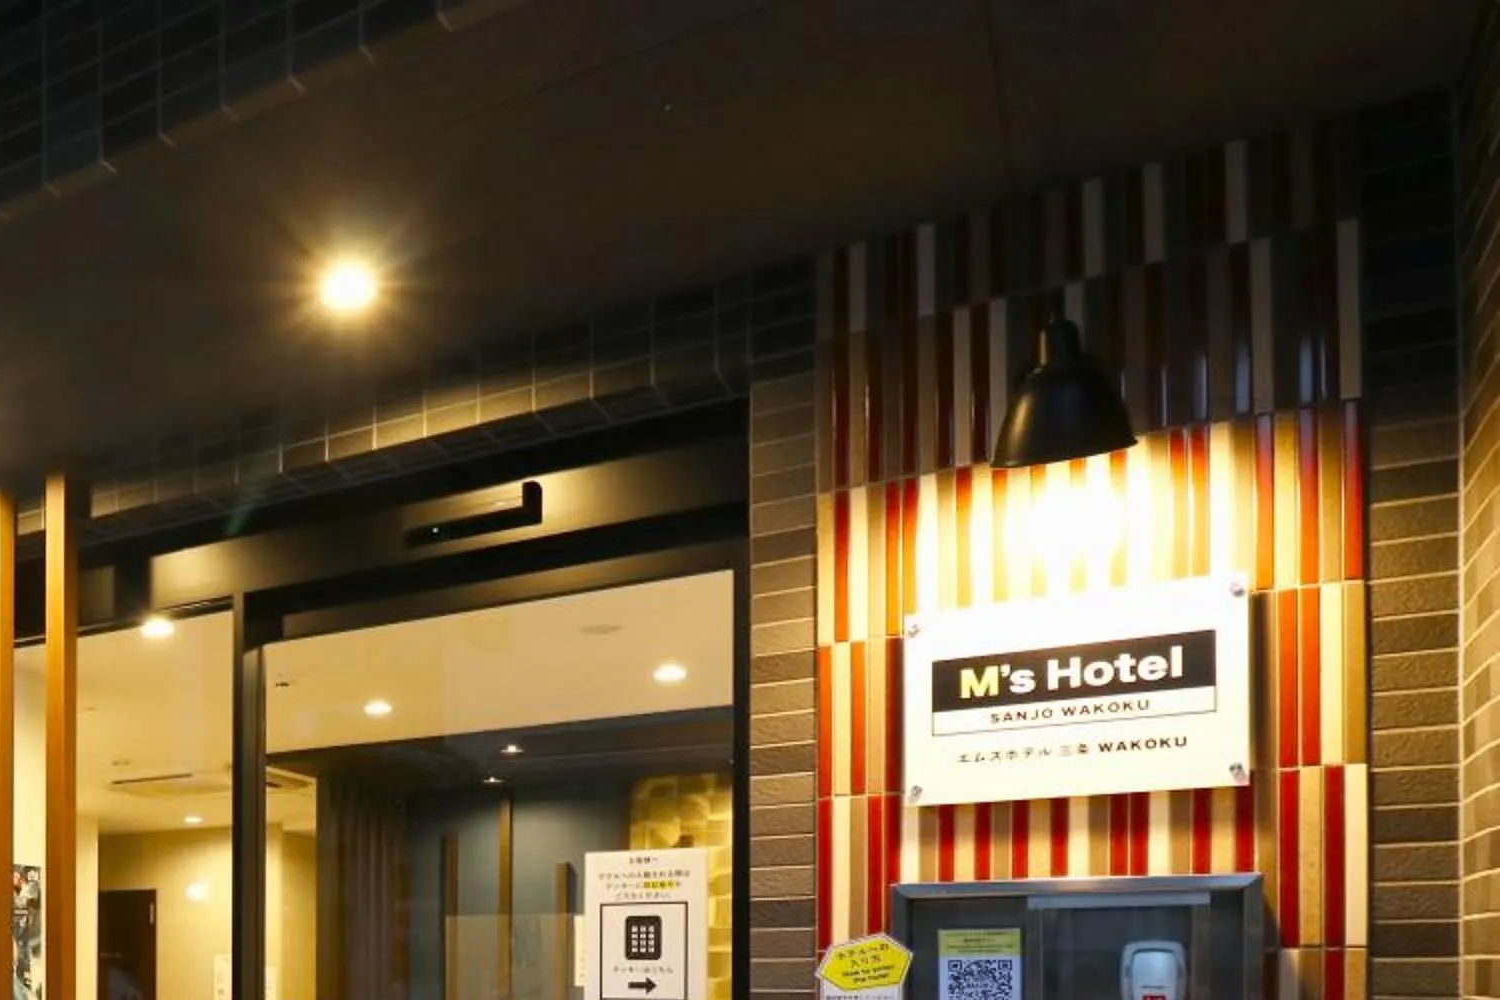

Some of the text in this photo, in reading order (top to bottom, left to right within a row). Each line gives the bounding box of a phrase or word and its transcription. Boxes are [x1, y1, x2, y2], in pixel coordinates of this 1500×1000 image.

[959, 645, 1184, 699] M's Hotel
[990, 699, 1151, 725] SANJO WAKOKU
[1098, 736, 1188, 753] WAKOKU
